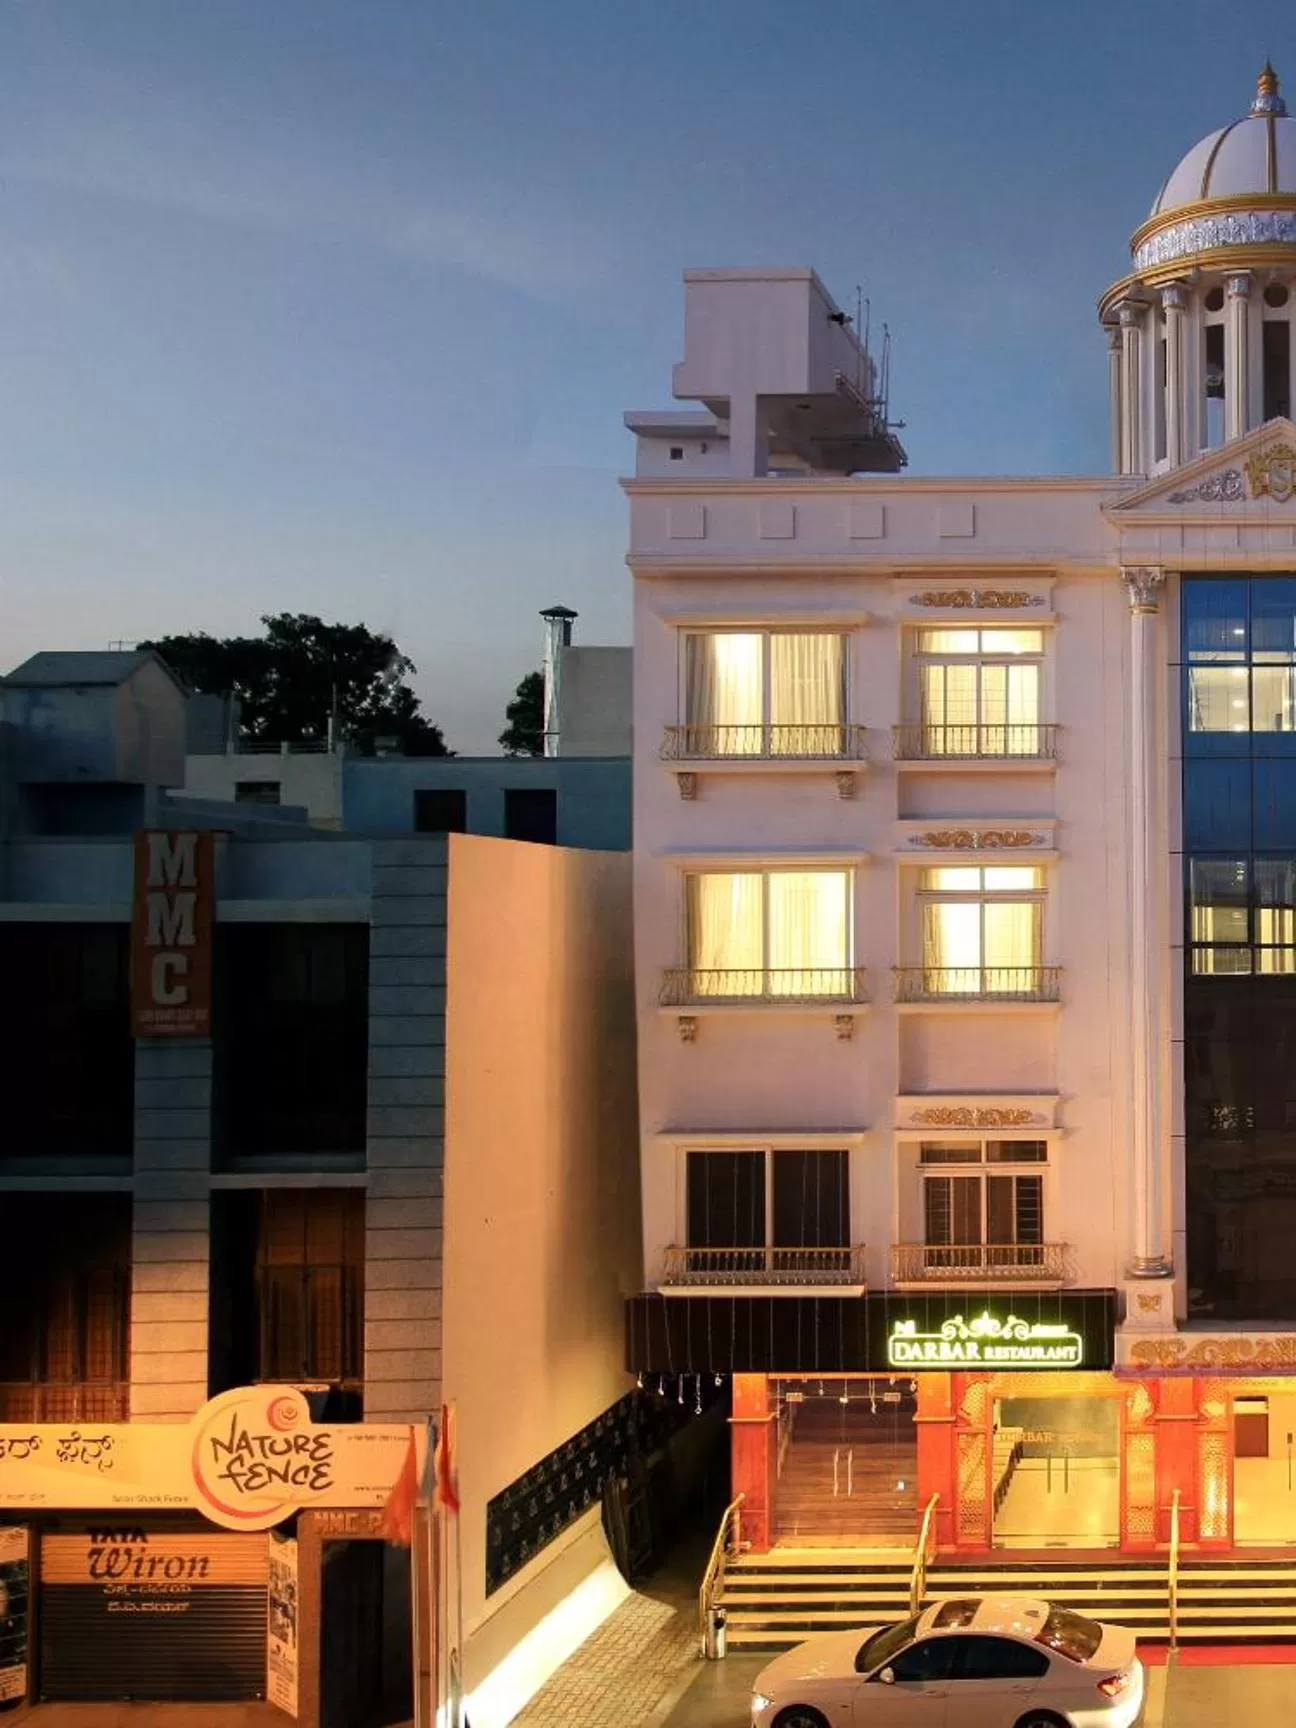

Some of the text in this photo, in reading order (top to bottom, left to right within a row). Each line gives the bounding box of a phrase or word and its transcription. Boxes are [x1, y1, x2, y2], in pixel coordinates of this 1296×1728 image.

[146, 832, 198, 1006] MMC
[895, 1341, 1077, 1360] DARBAR RESTAURANT
[210, 1412, 334, 1463] NATURE
[217, 1453, 334, 1493] FENCE
[88, 1527, 149, 1543] TATA
[88, 1546, 210, 1579] Wiron
